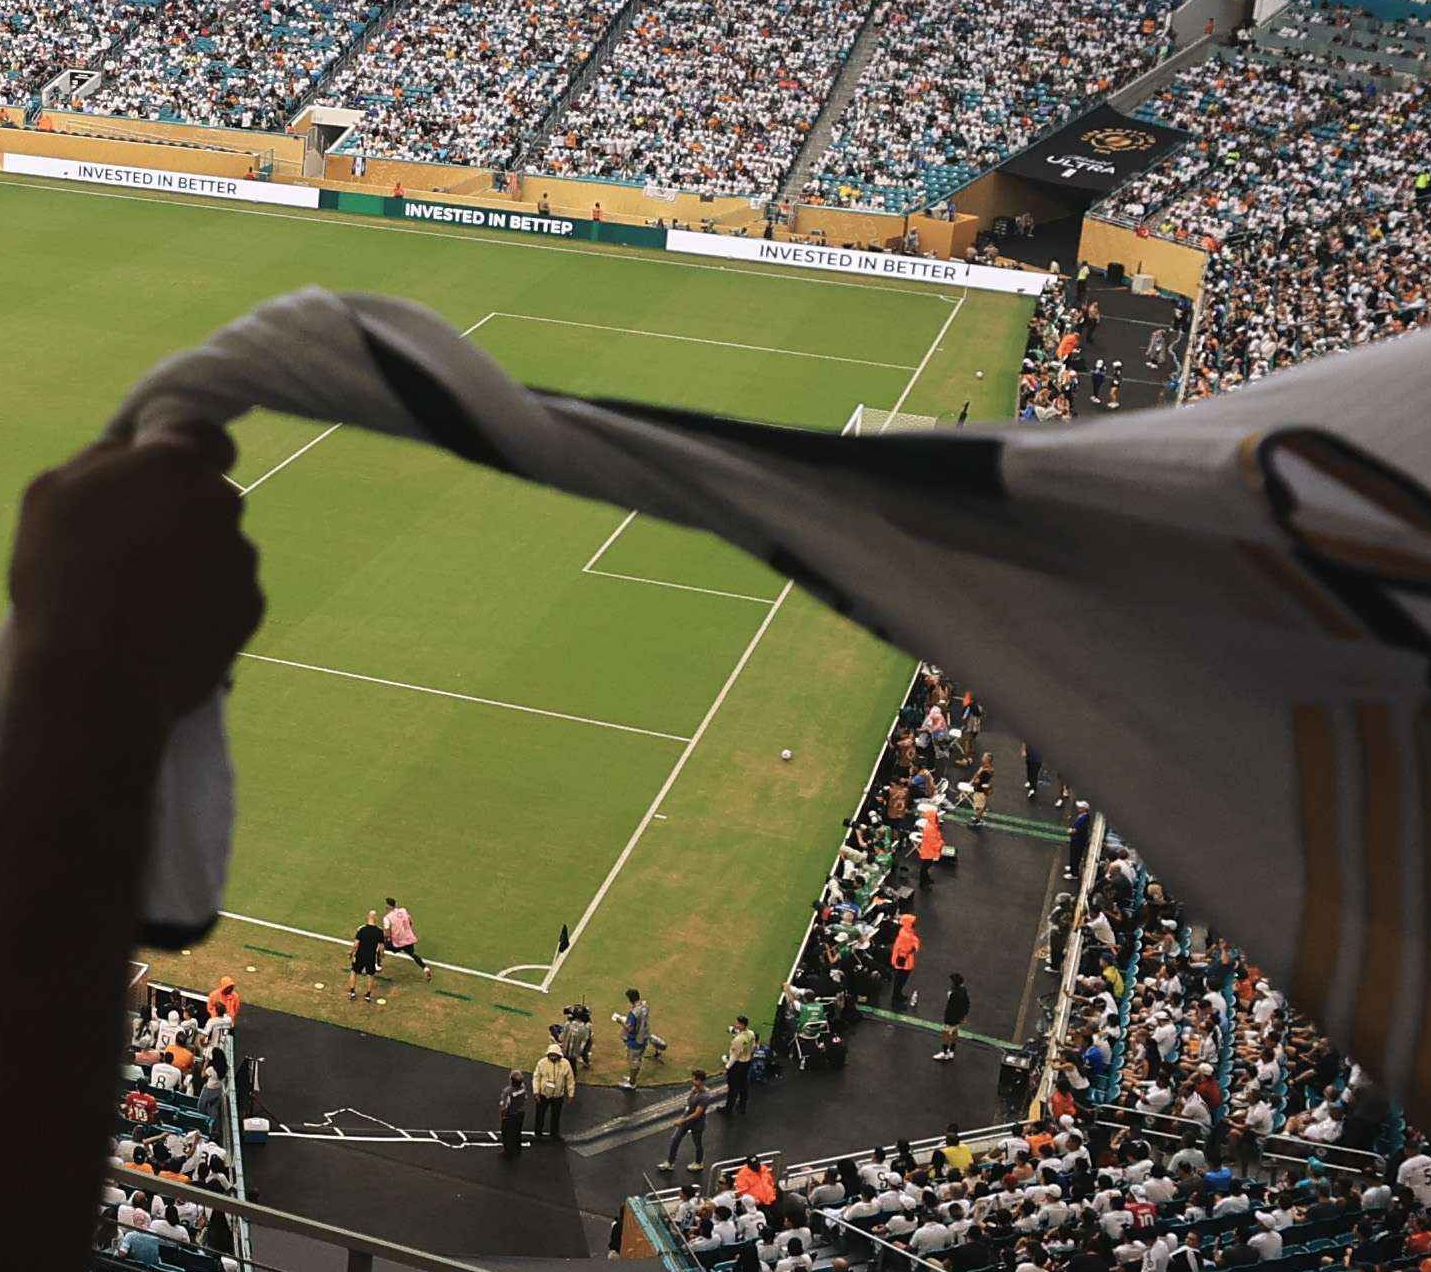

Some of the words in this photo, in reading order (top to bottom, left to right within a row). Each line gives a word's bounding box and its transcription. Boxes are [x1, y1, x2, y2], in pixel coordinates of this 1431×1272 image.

[1047, 154, 1116, 176] ULTRA
[78, 165, 153, 185] INVESTED
[158, 174, 173, 187] IN
[179, 176, 237, 195] BETTER
[405, 203, 485, 225] INVESTED
[489, 213, 505, 227] IN
[760, 244, 852, 267] INVESTED
[859, 255, 877, 270] IN
[884, 259, 956, 280] BETTER
